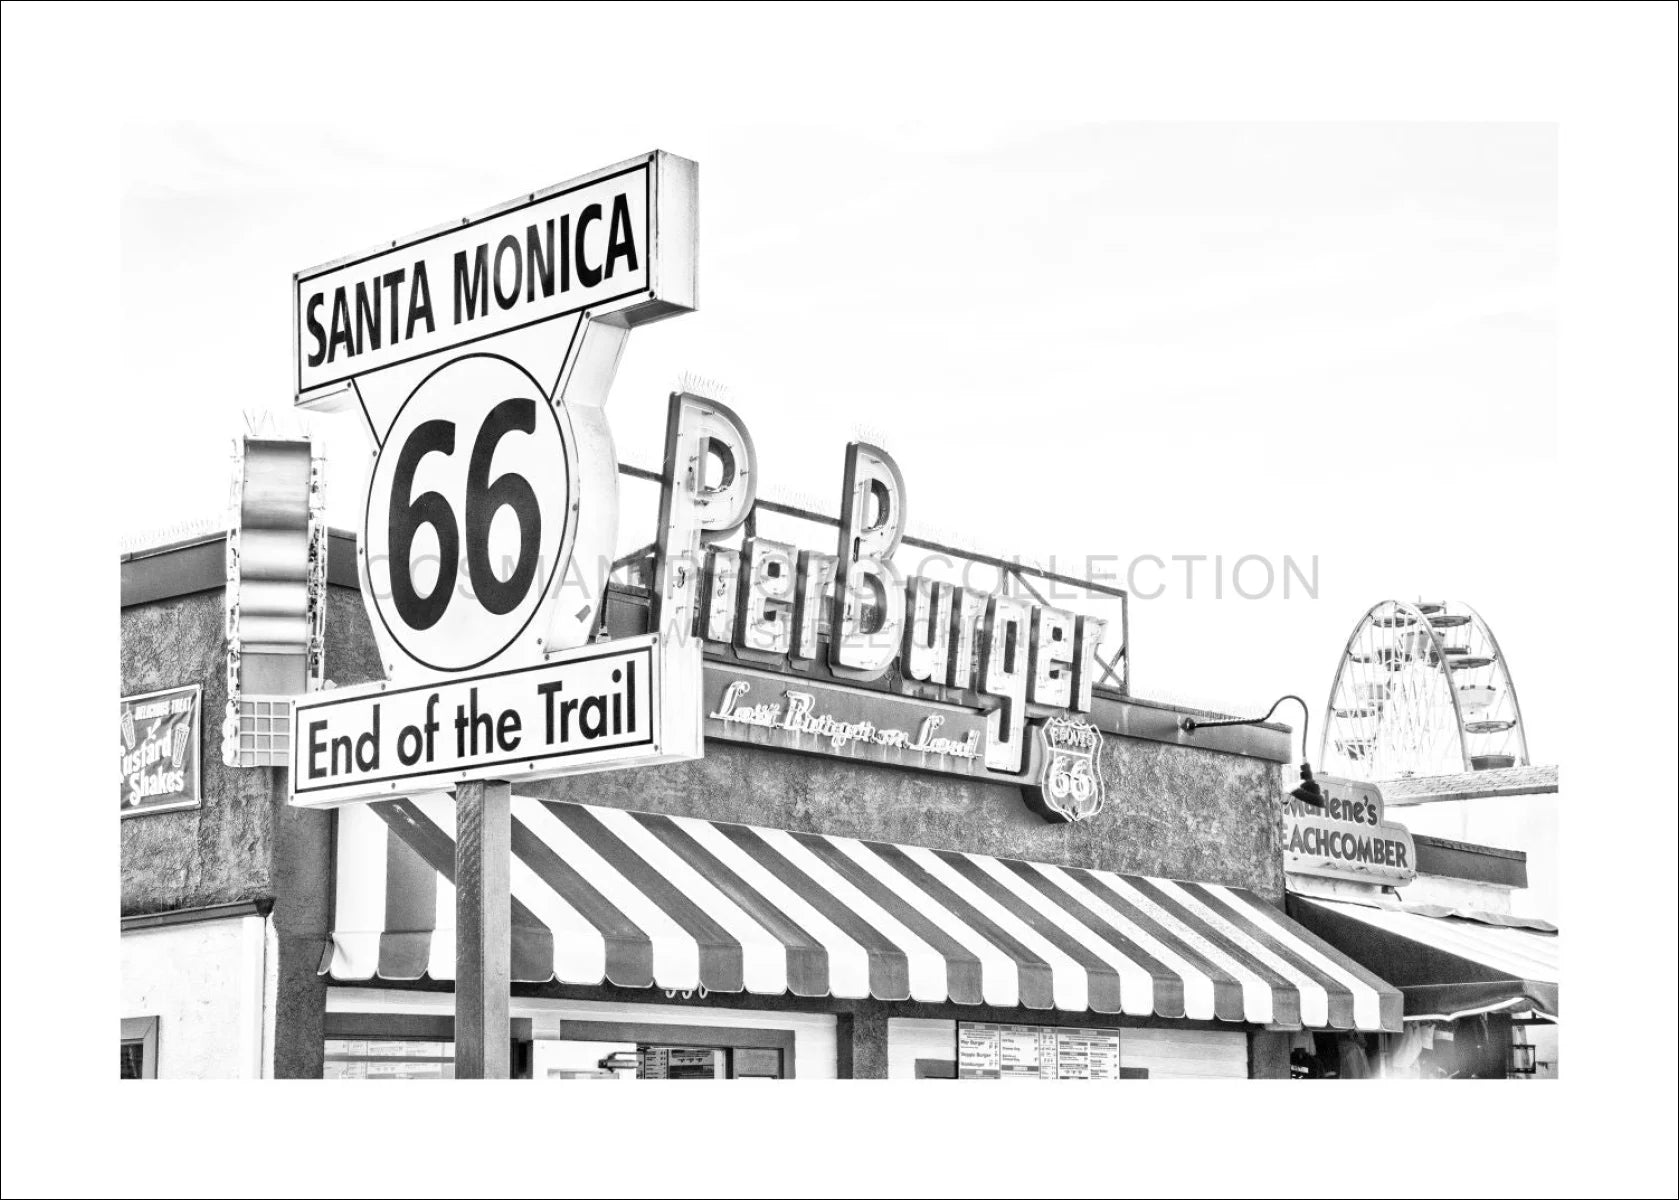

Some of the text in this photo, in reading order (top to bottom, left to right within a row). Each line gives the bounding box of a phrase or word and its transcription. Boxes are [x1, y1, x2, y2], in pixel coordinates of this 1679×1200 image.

[306, 192, 639, 368] SANTA MONICA
[388, 397, 542, 632] 66
[309, 660, 636, 779] End of the Trail
[1050, 756, 1093, 802] 66
[129, 766, 185, 806] Shakes
